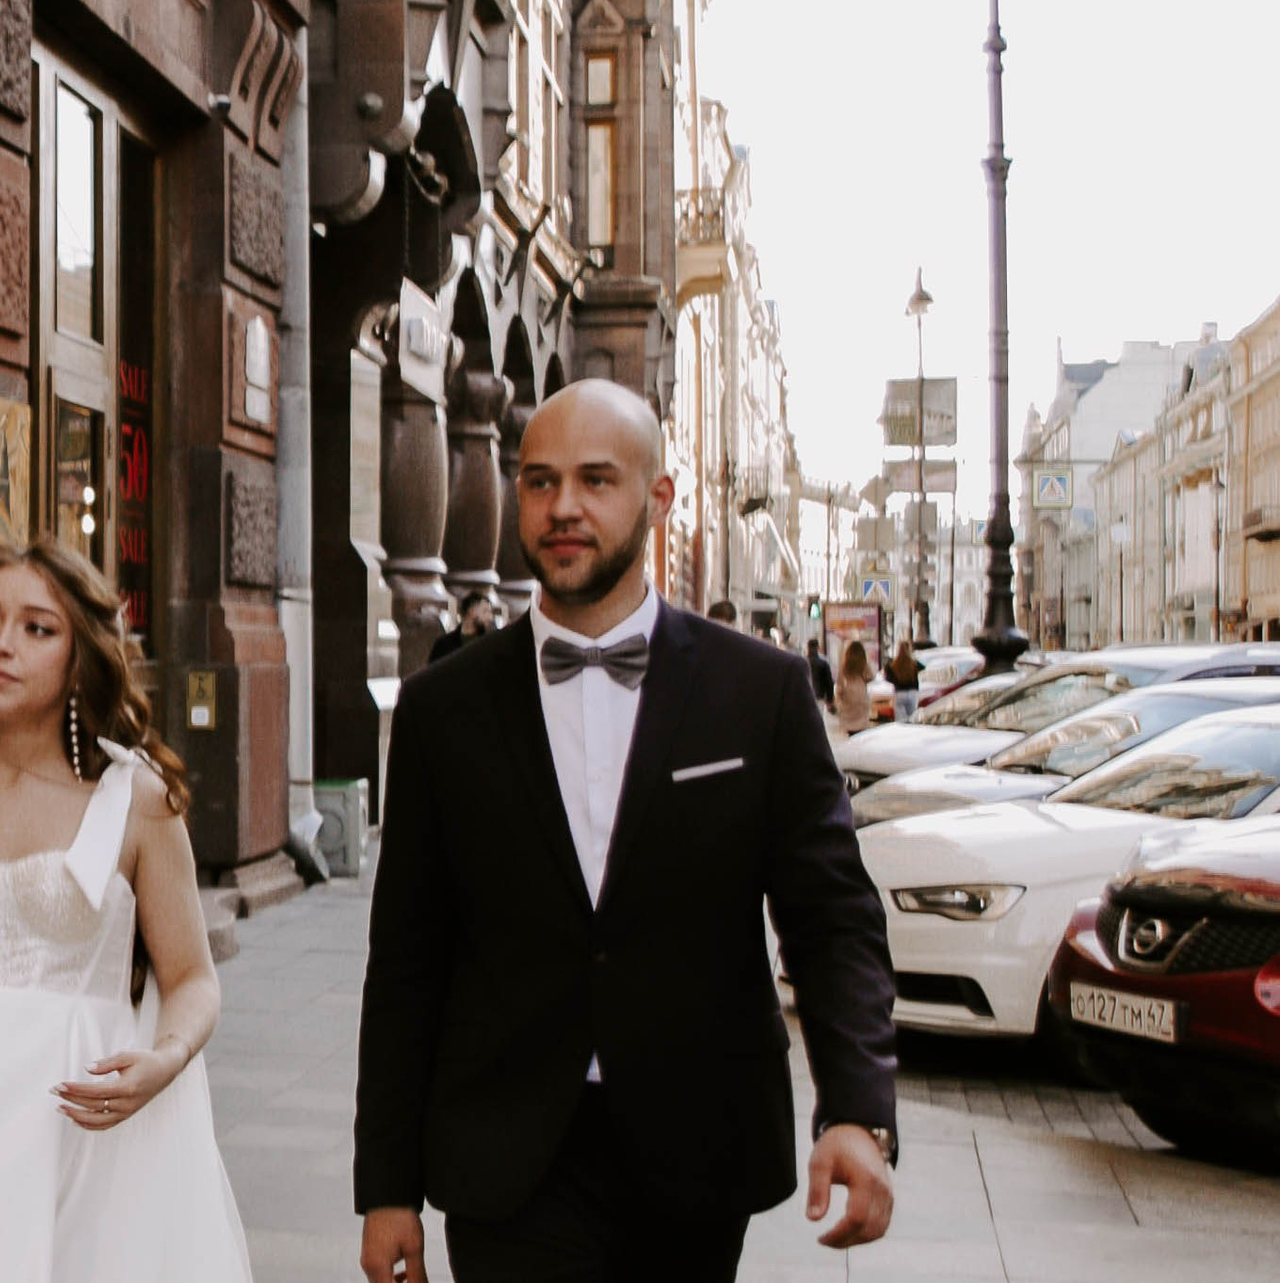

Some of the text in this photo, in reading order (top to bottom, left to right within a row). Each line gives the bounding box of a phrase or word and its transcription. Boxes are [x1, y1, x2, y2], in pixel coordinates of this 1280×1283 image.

[120, 359, 148, 405] SALE
[120, 423, 148, 503] 50
[120, 525, 148, 564] SALE
